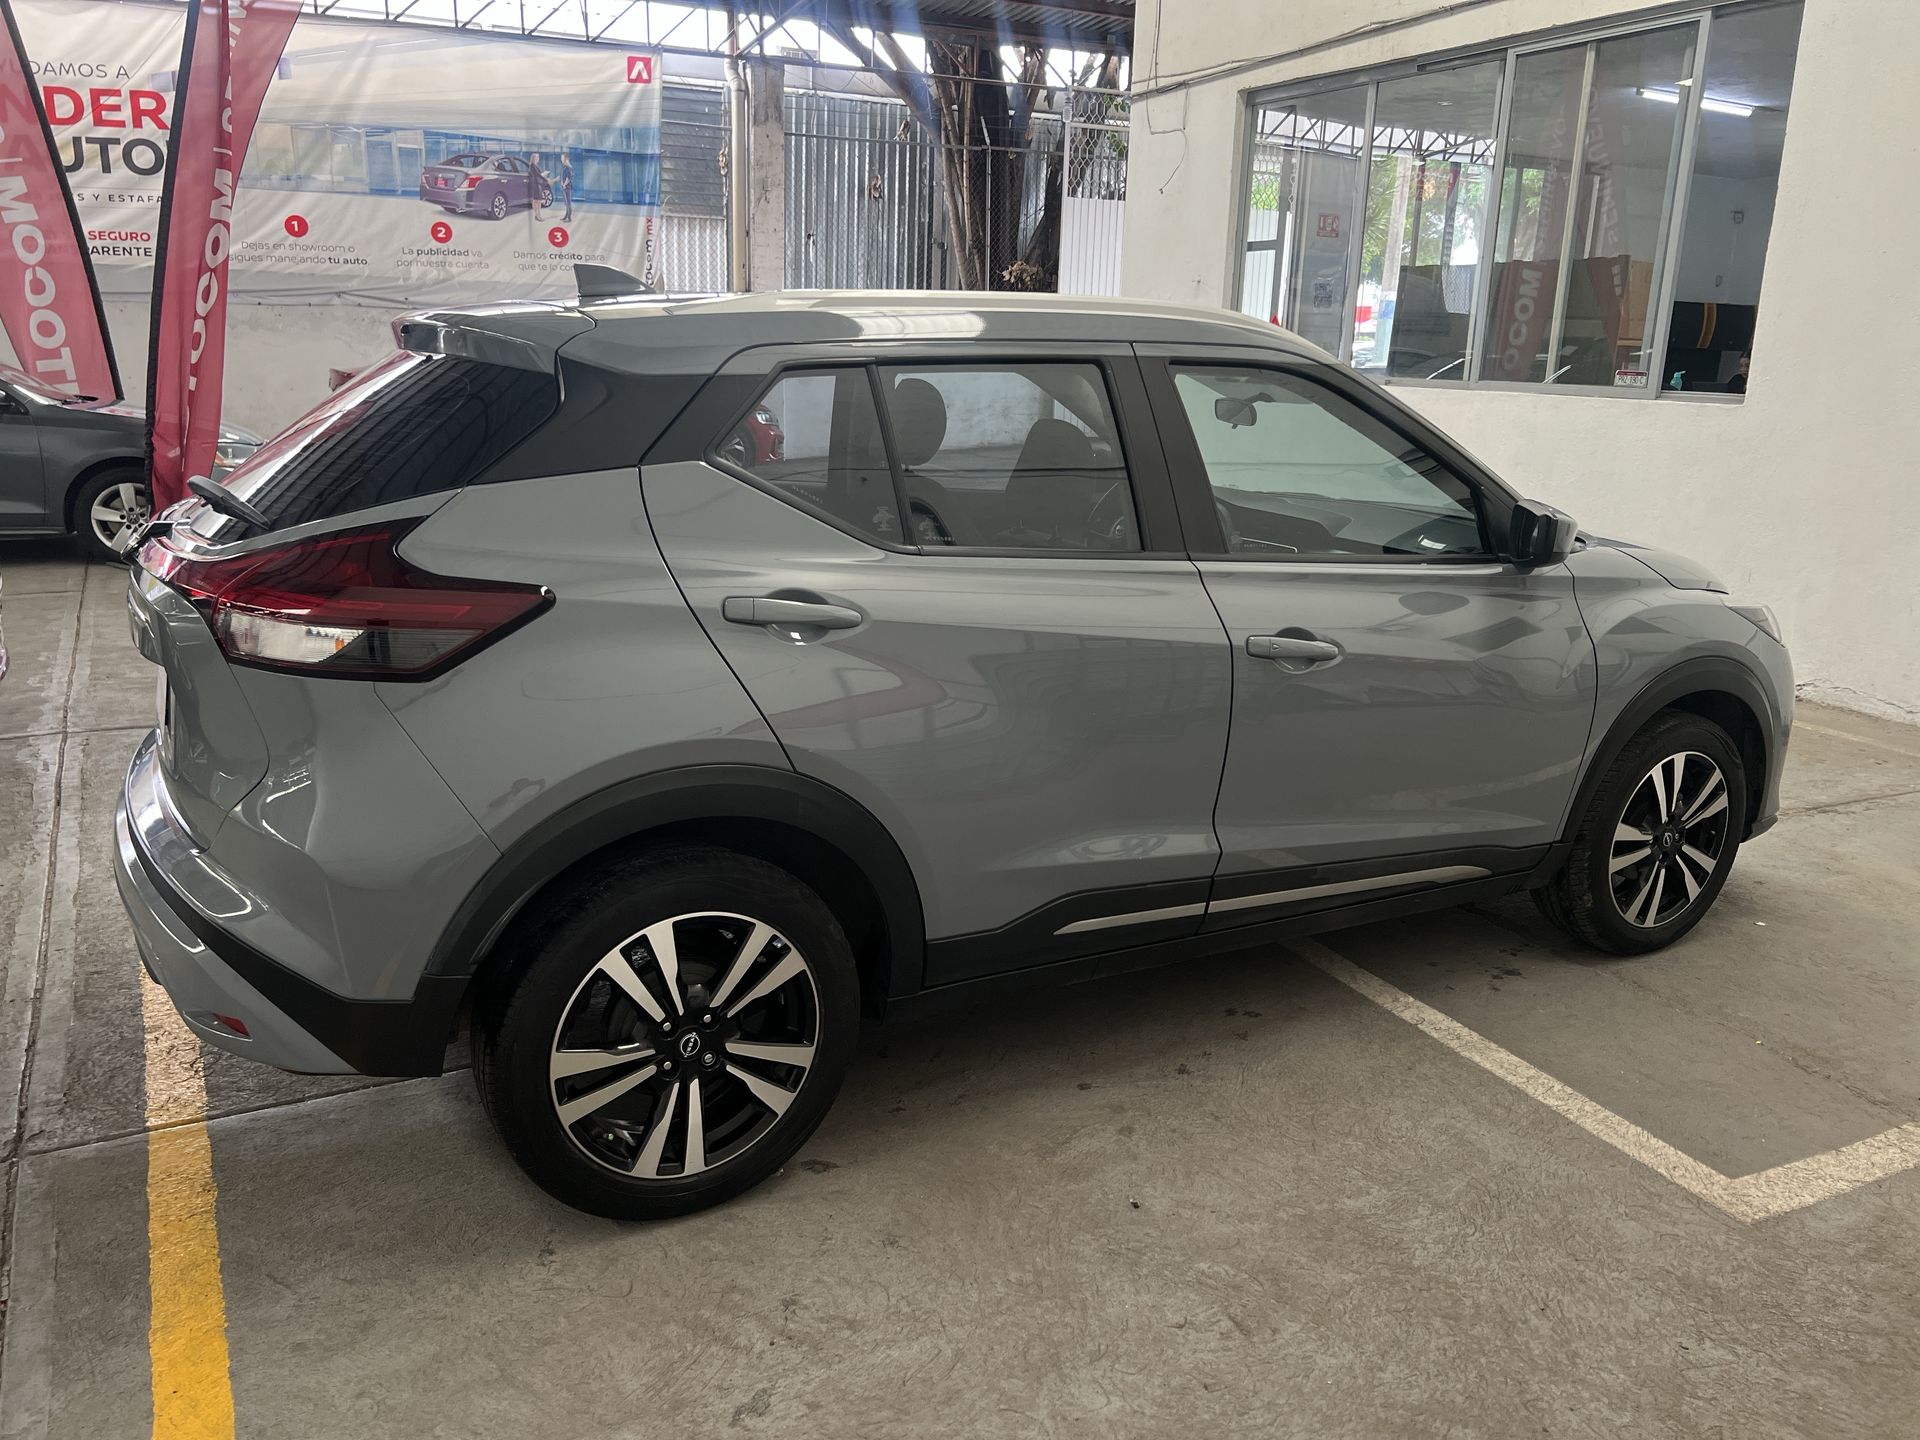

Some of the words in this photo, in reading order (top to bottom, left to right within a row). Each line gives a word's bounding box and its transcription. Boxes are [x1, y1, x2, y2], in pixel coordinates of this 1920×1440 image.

[30, 60, 108, 78] DAMOS
[116, 65, 131, 79] A
[43, 85, 170, 130] DER
[63, 136, 165, 176] UTO
[77, 193, 85, 202] S
[92, 193, 100, 202] Y
[108, 194, 162, 203] ESTAFA
[88, 230, 151, 242] SEGURO
[90, 245, 152, 257] ARENTE
[241, 241, 270, 251] Dejas
[288, 242, 346, 253] showroom
[347, 245, 356, 253] o
[401, 247, 414, 256] La
[416, 247, 469, 258] publicidad
[470, 250, 483, 258] va
[228, 253, 264, 264] sigues
[265, 254, 327, 265] manejando
[328, 256, 341, 265] tu
[513, 250, 547, 260] Damos
[549, 250, 583, 261] crédito
[584, 253, 606, 263] para
[396, 259, 413, 269] por
[415, 259, 454, 269] nuestra
[455, 260, 489, 270] cuenta
[518, 262, 536, 273] que
[537, 262, 548, 271] te
